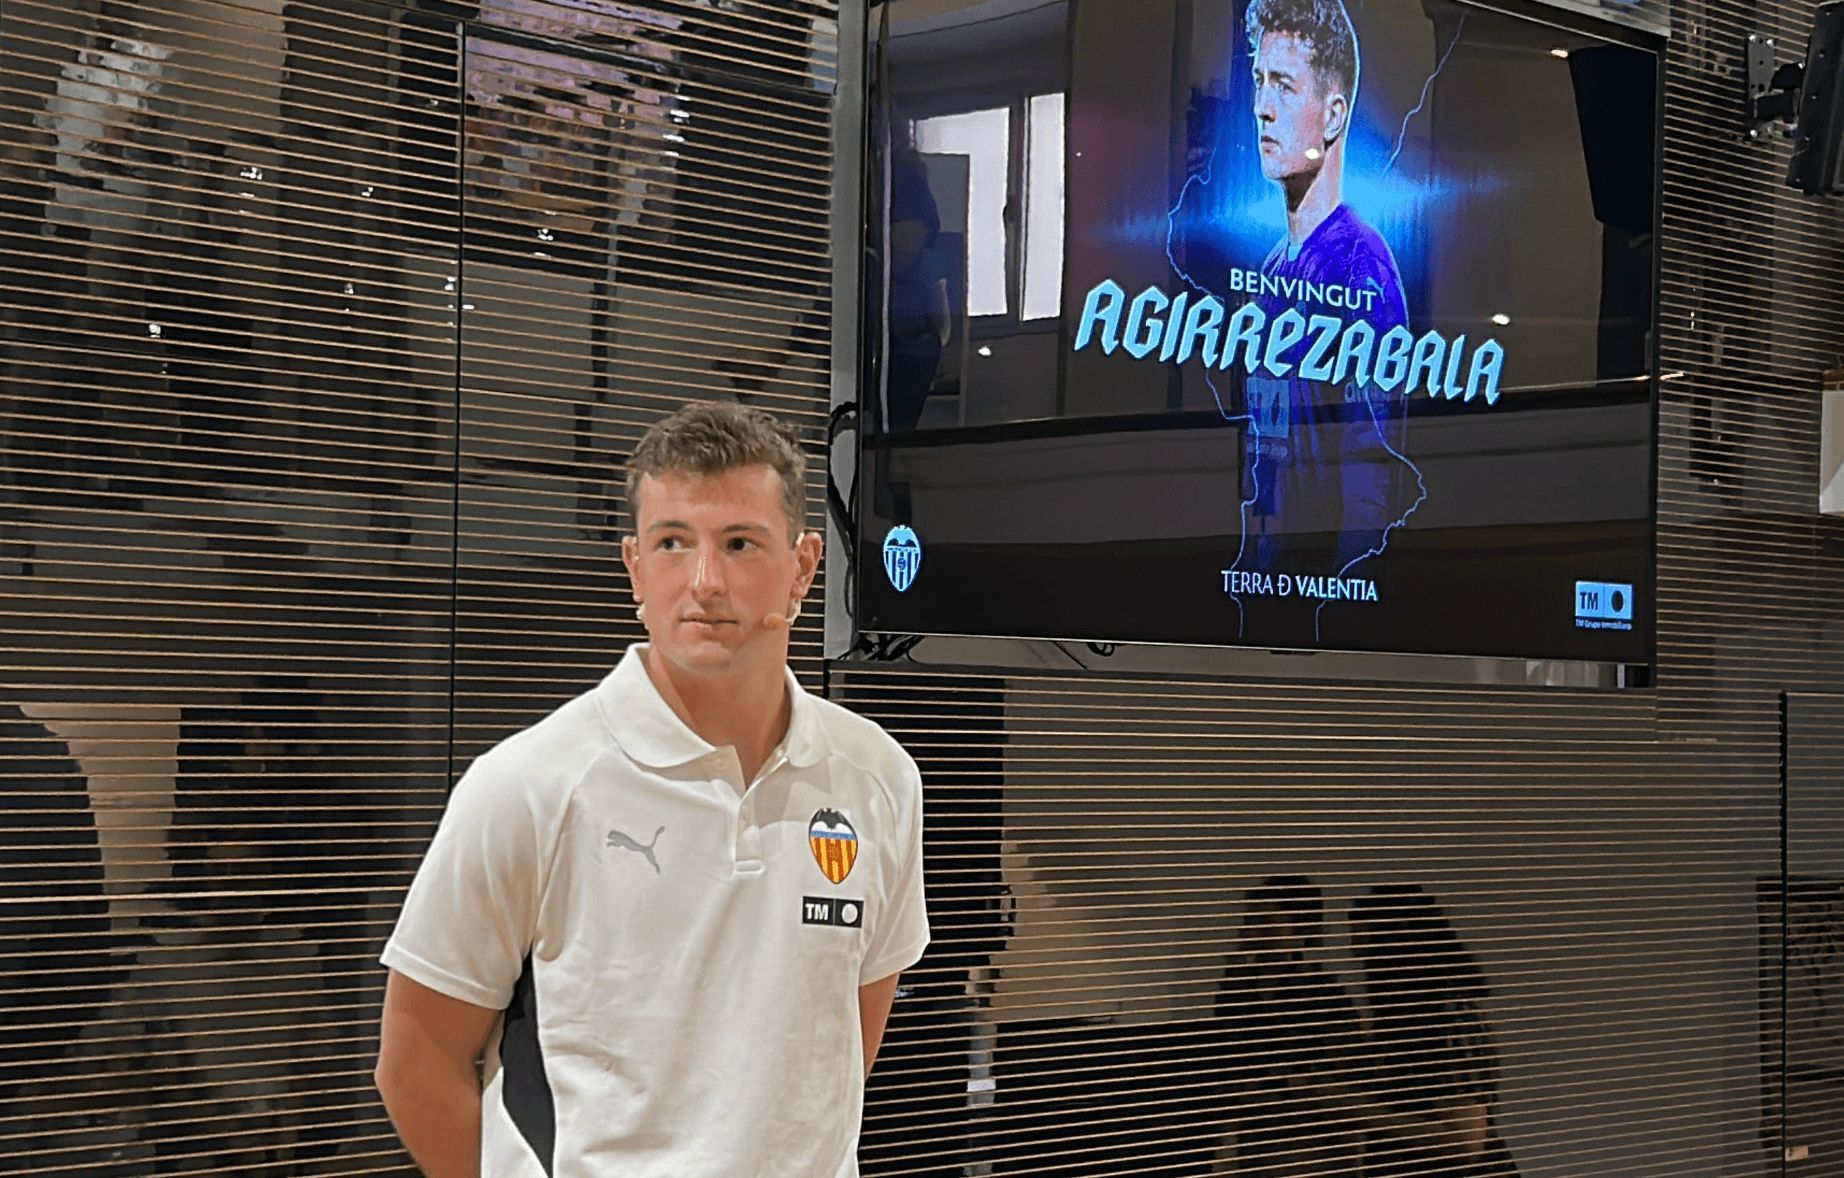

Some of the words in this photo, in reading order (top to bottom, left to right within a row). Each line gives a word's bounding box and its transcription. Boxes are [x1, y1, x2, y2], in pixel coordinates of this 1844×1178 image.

[1229, 267, 1377, 312] BENVINGUT
[1221, 570, 1273, 595] TERRA
[1295, 575, 1378, 601] VALENTIA
[1579, 591, 1598, 610] TM
[804, 903, 829, 921] TM
